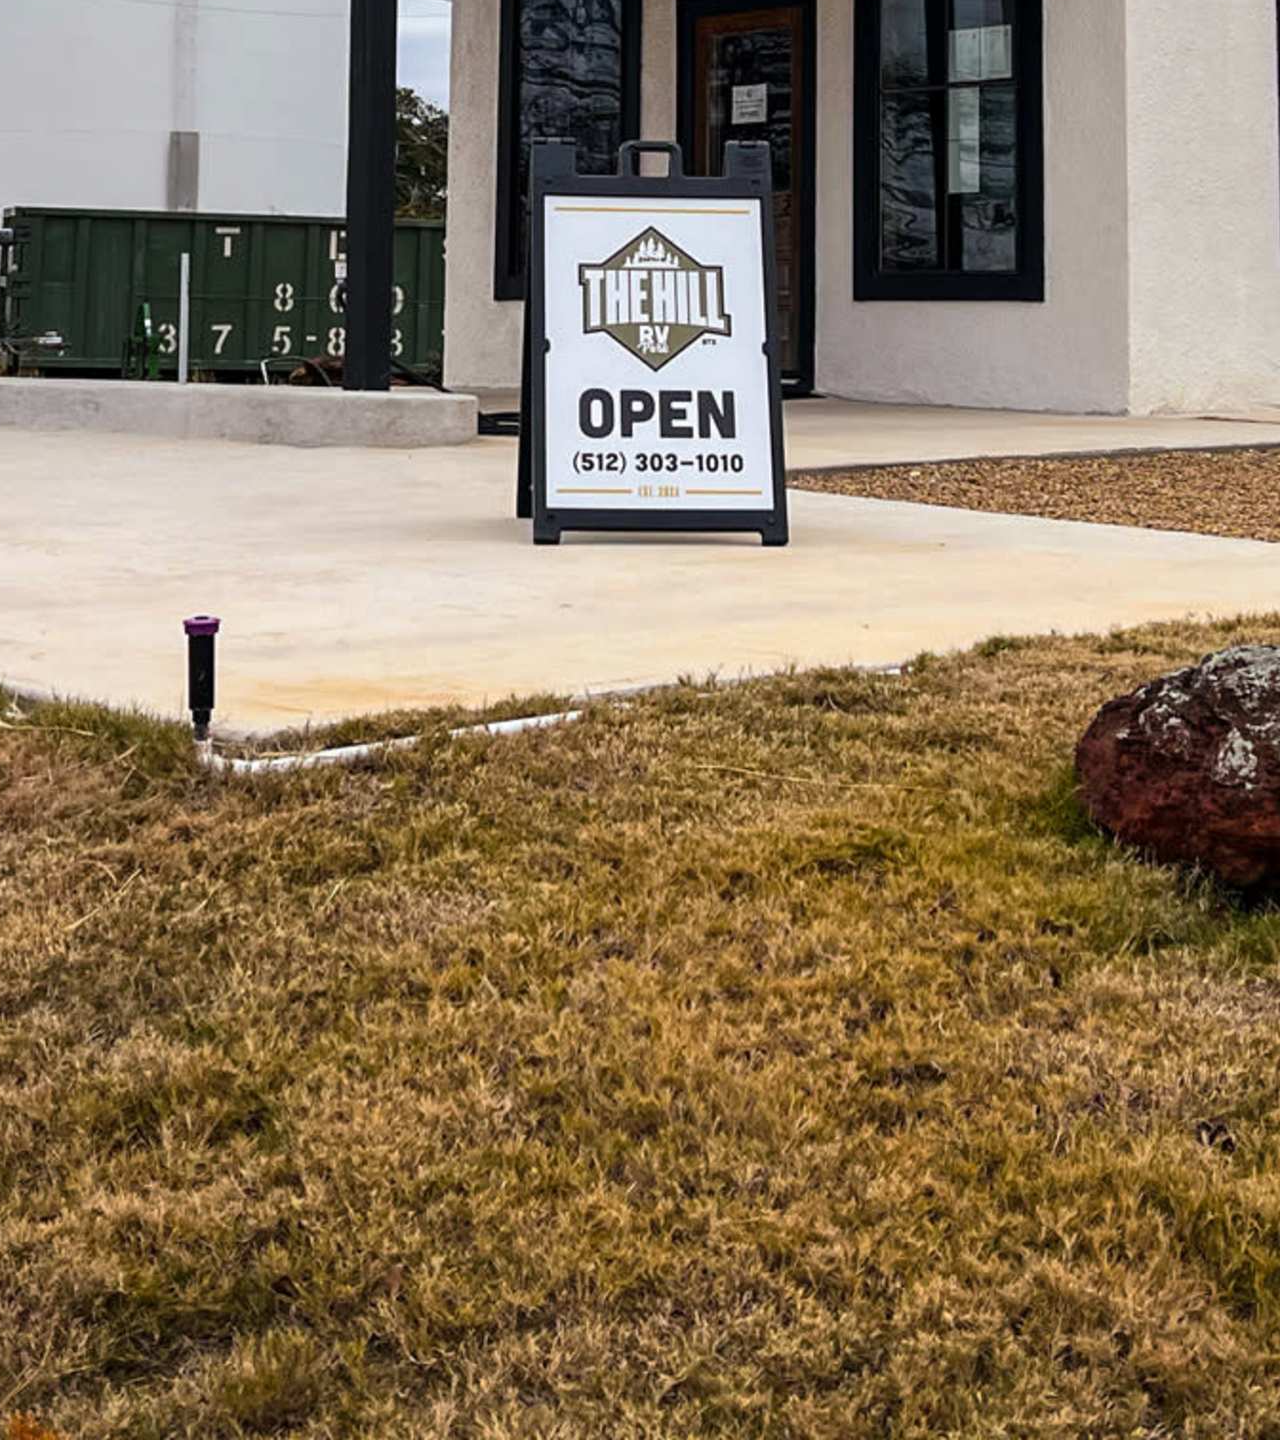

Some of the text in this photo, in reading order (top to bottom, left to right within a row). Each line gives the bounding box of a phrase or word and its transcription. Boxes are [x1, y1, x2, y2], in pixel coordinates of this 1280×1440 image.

[639, 325, 670, 345] RV
[578, 387, 737, 439] OPEN
[572, 451, 744, 474] (512) 303-1010
